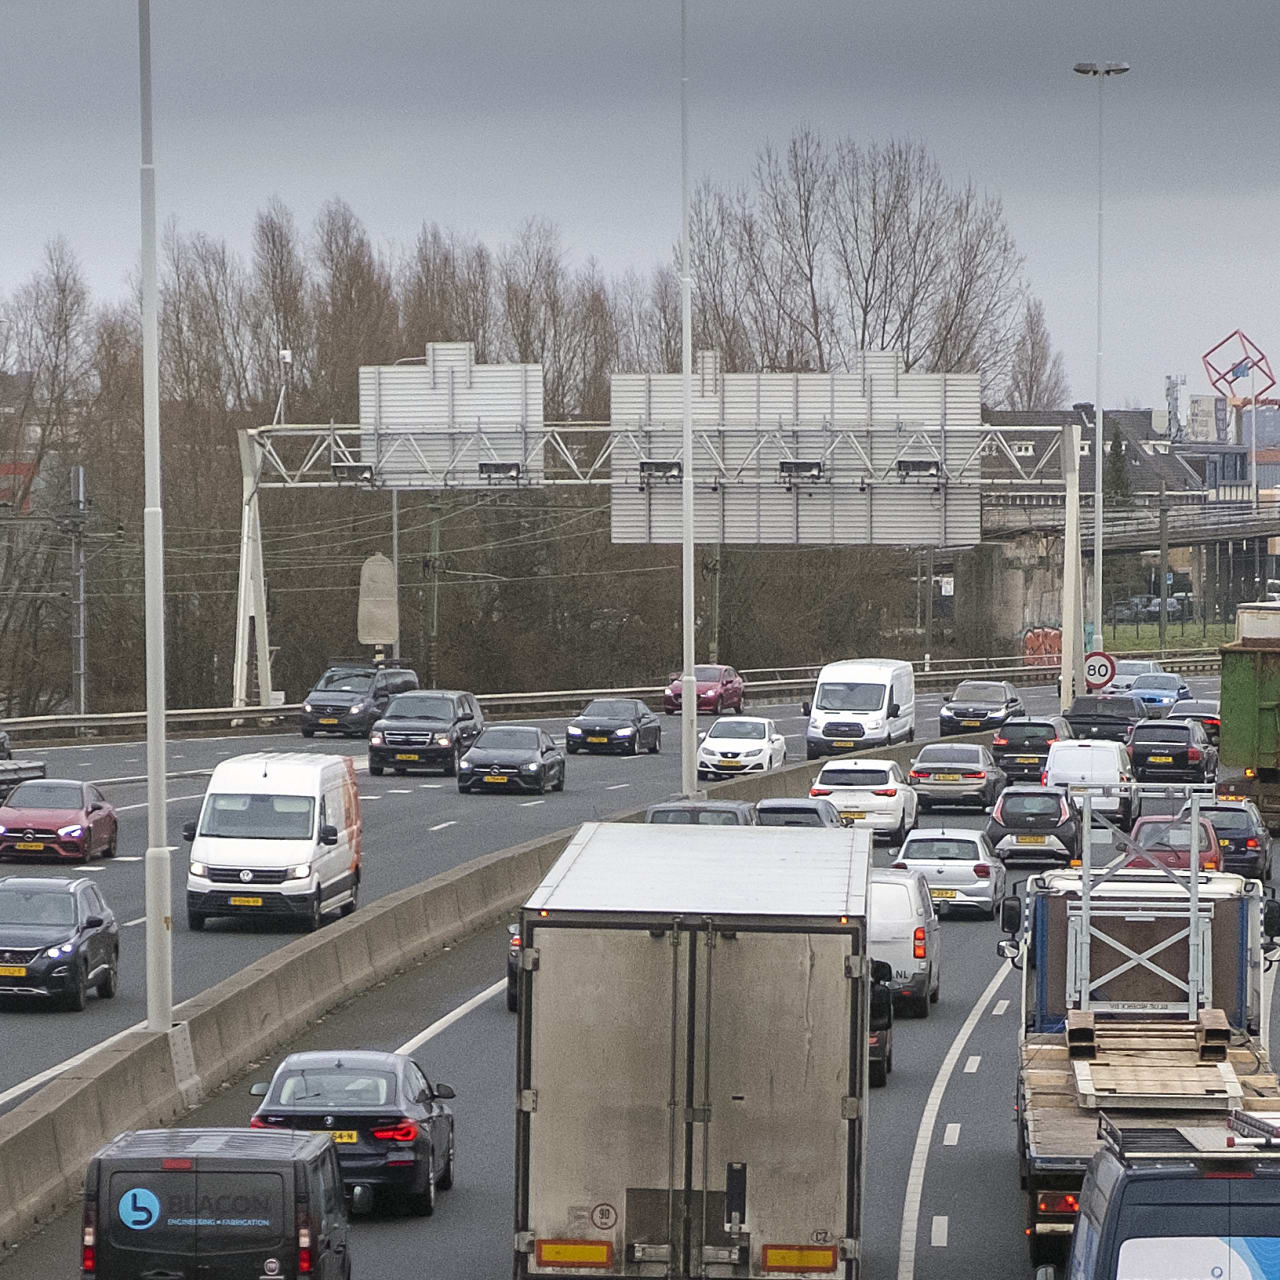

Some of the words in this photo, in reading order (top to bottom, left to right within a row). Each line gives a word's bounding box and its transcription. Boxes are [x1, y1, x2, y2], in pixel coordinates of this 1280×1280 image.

[1087, 664, 1109, 678] 80
[168, 1195, 272, 1214] BLACON
[598, 1208, 610, 1220] 90
[222, 1218, 270, 1226] FABRICATION
[815, 1232, 828, 1242] CZ
